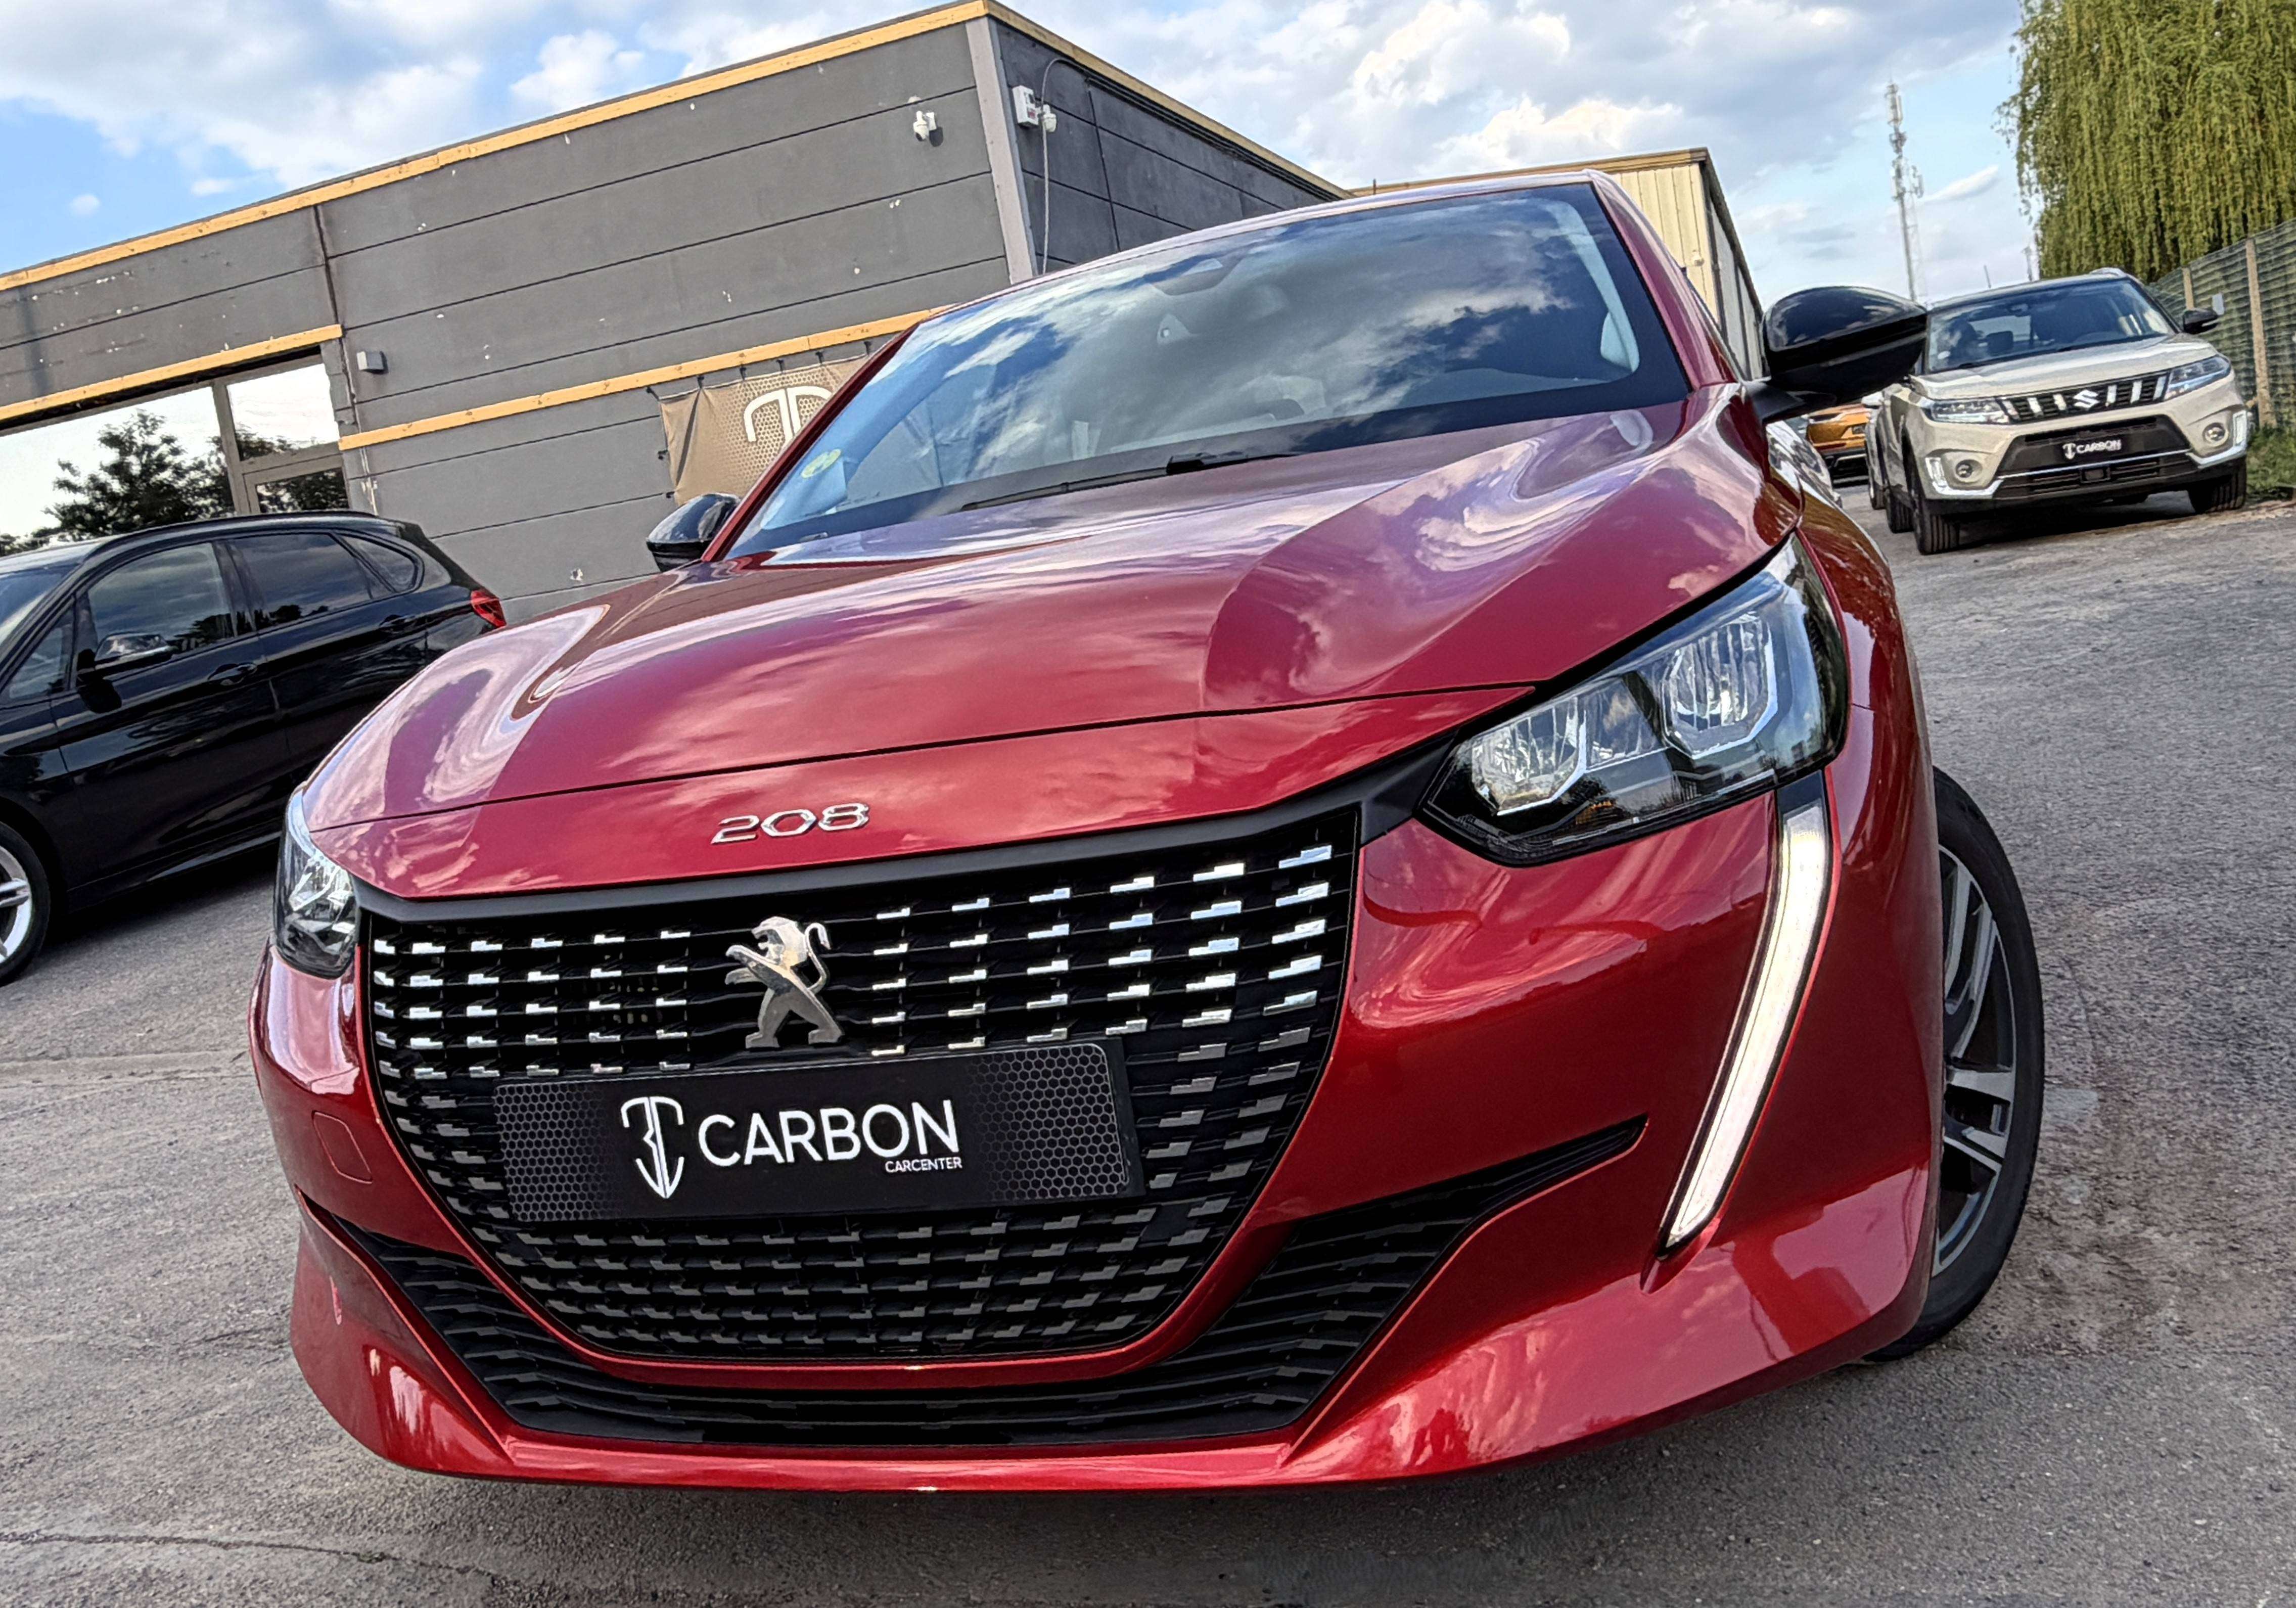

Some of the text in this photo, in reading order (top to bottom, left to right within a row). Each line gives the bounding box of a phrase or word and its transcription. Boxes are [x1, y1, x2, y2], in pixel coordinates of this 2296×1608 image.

[2076, 439, 2122, 454] CARBON
[711, 802, 869, 844] 208
[698, 1099, 959, 1167] CARBON
[885, 1156, 962, 1173] CARCENTER
